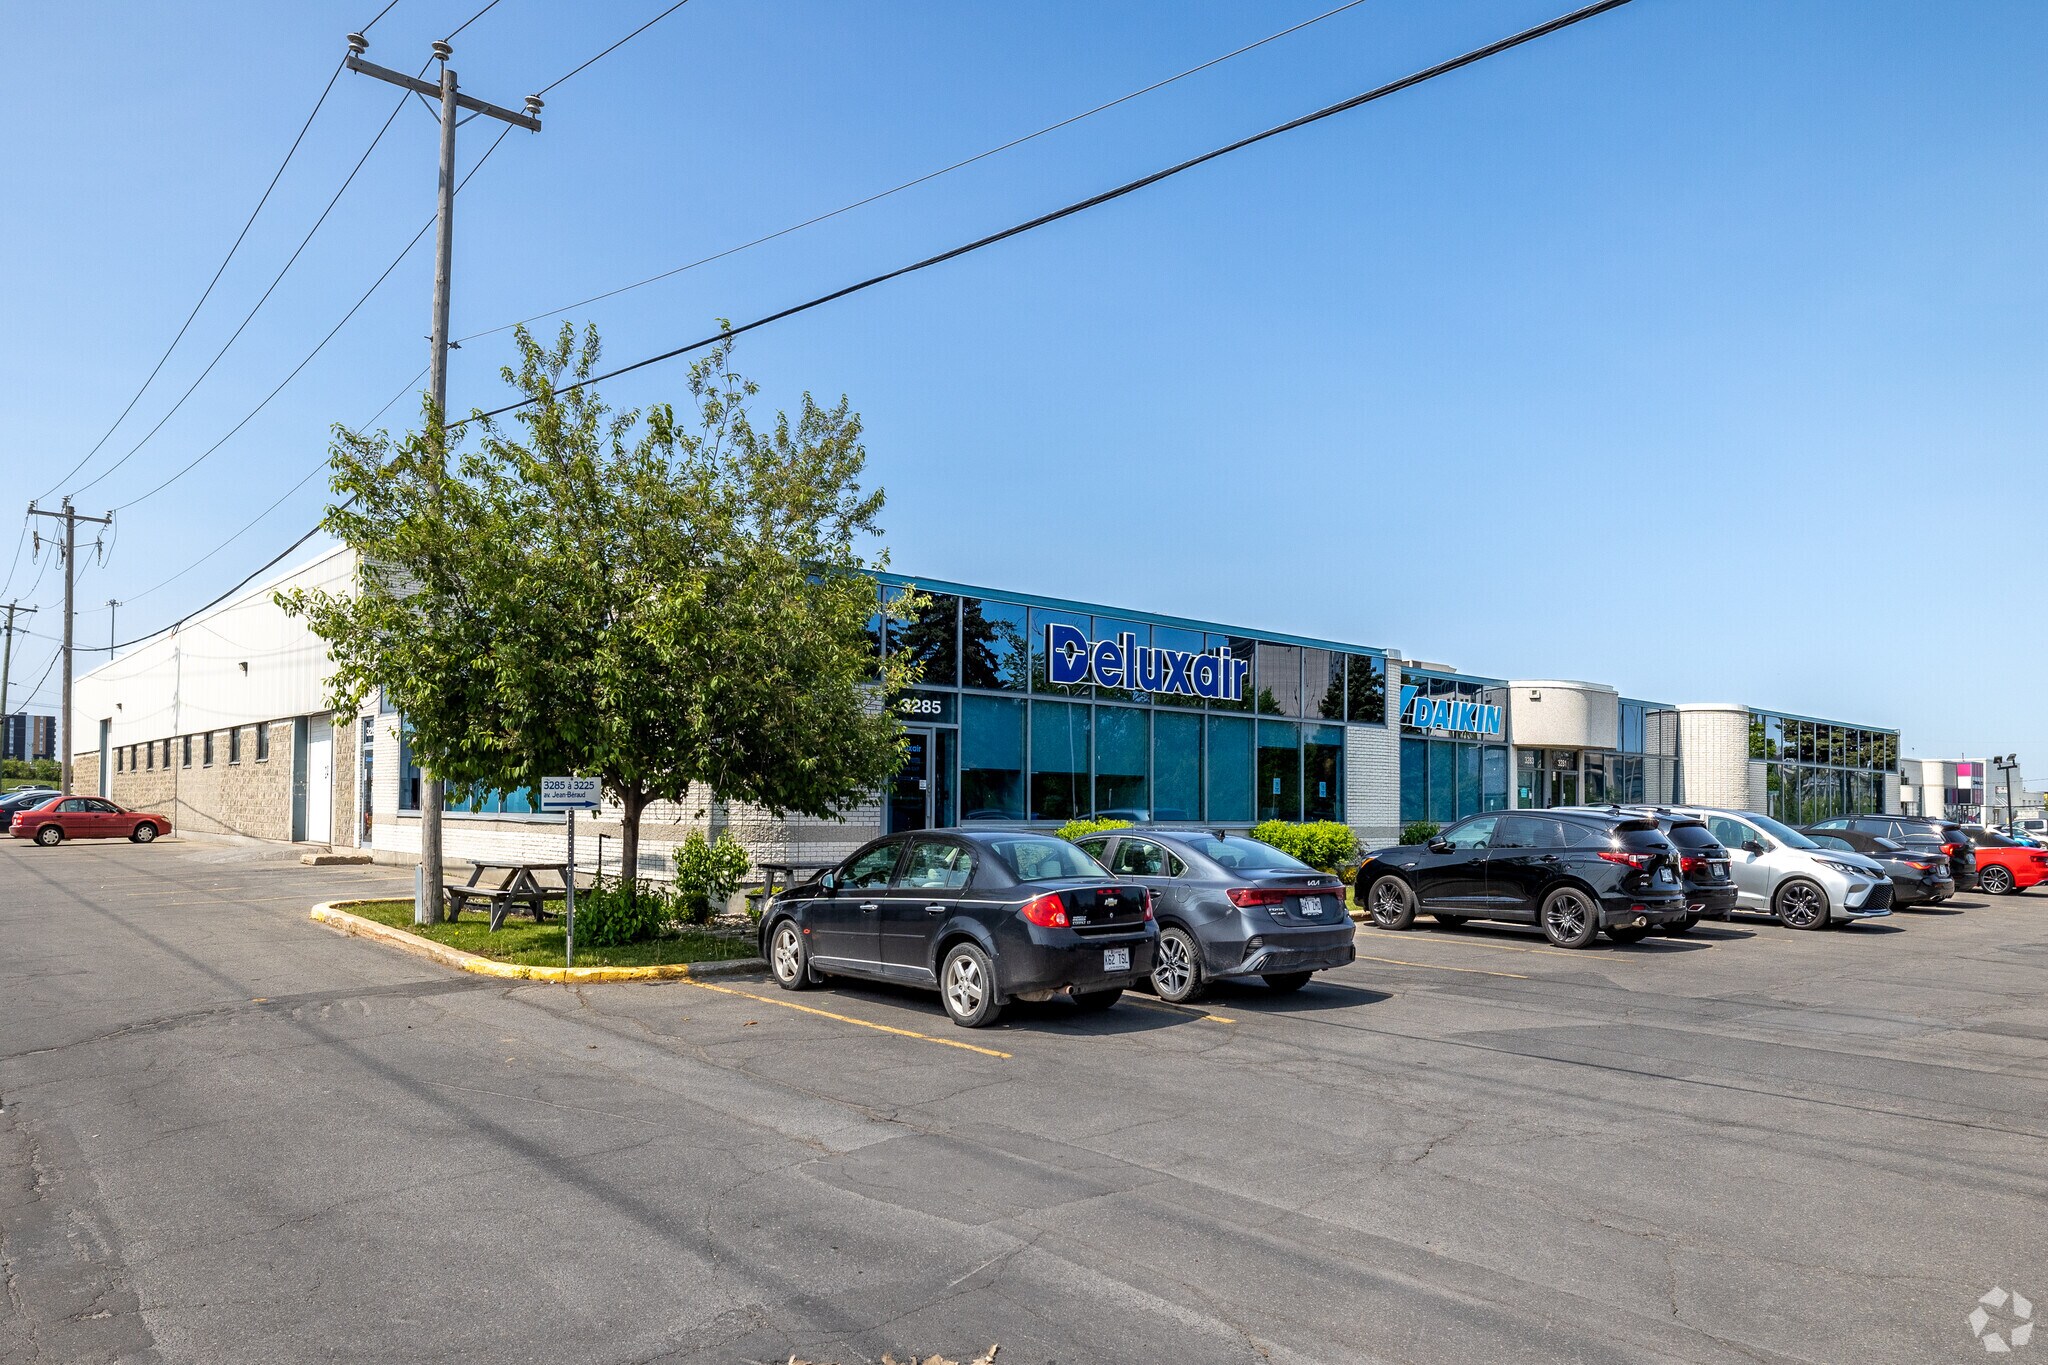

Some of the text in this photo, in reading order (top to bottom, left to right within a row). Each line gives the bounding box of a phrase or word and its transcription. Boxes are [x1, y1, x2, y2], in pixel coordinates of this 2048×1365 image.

[1046, 622, 1248, 702] Deluxair
[900, 698, 942, 714] 3285
[1412, 696, 1502, 735] DAIKIN
[543, 781, 566, 790] 3285
[573, 781, 595, 790] 3225
